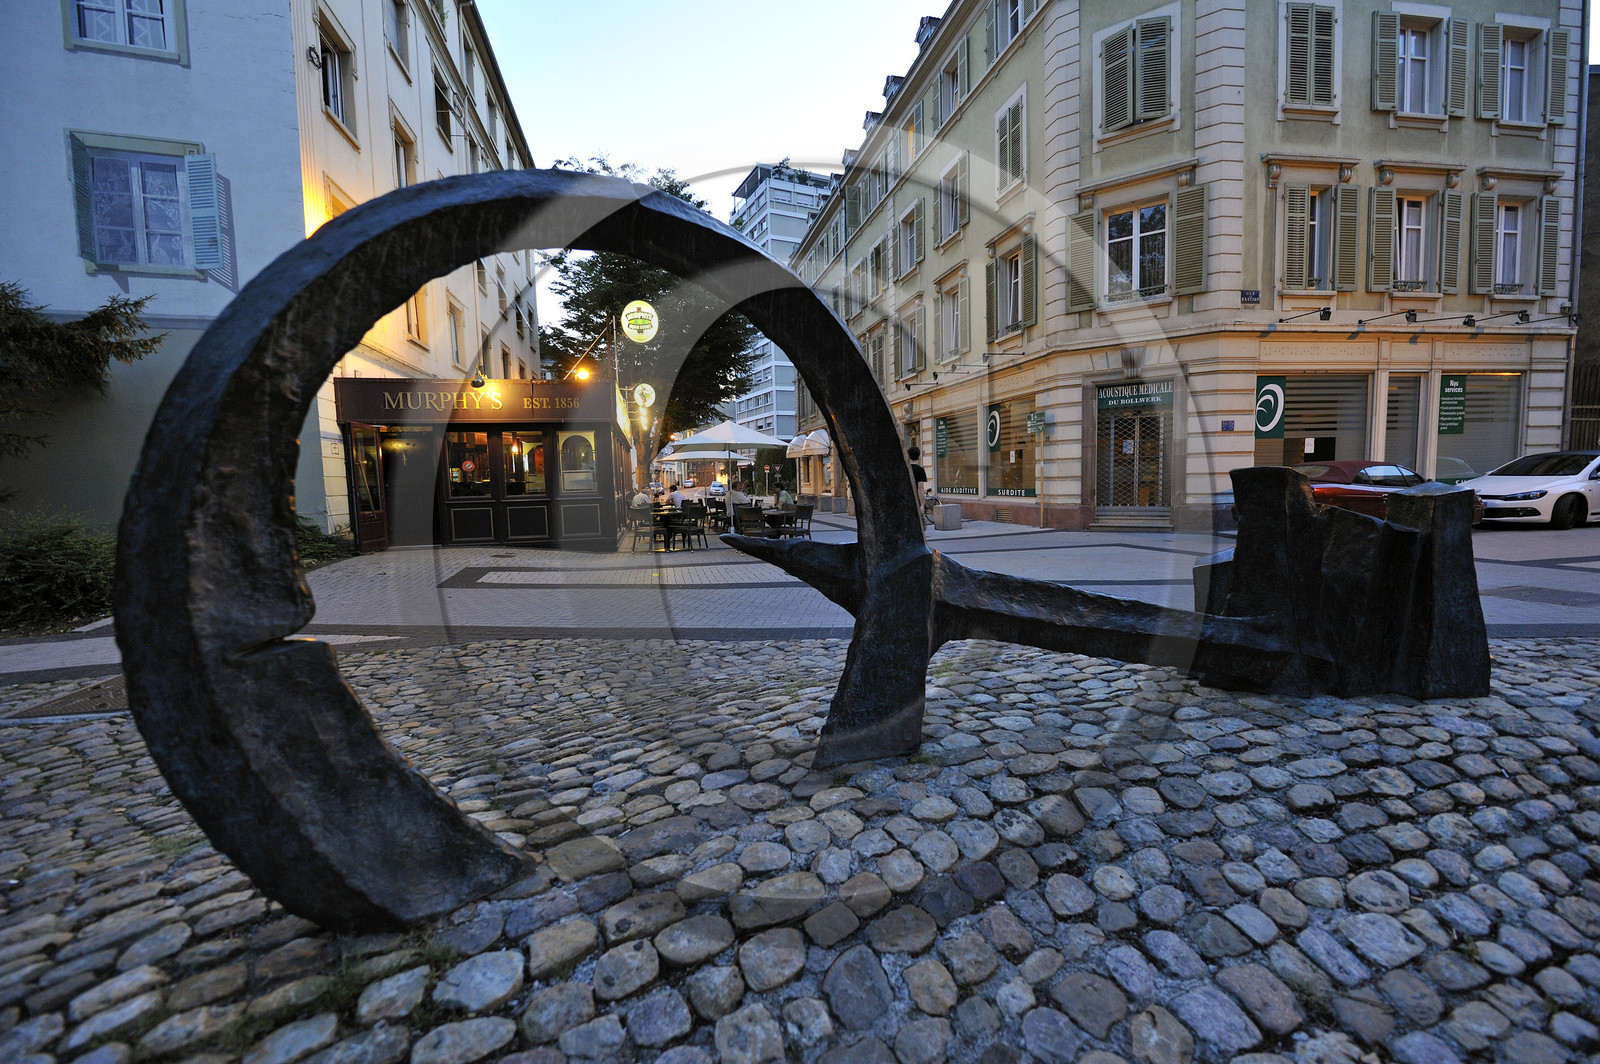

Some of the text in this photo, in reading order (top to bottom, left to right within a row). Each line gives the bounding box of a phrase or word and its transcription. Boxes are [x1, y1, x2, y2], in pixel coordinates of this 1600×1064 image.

[1099, 382, 1174, 398] ACOUSTIQUE MEDICALE
[383, 391, 579, 412] MURPHY'S EST. 1856
[1120, 396, 1162, 405] BOLLWERK
